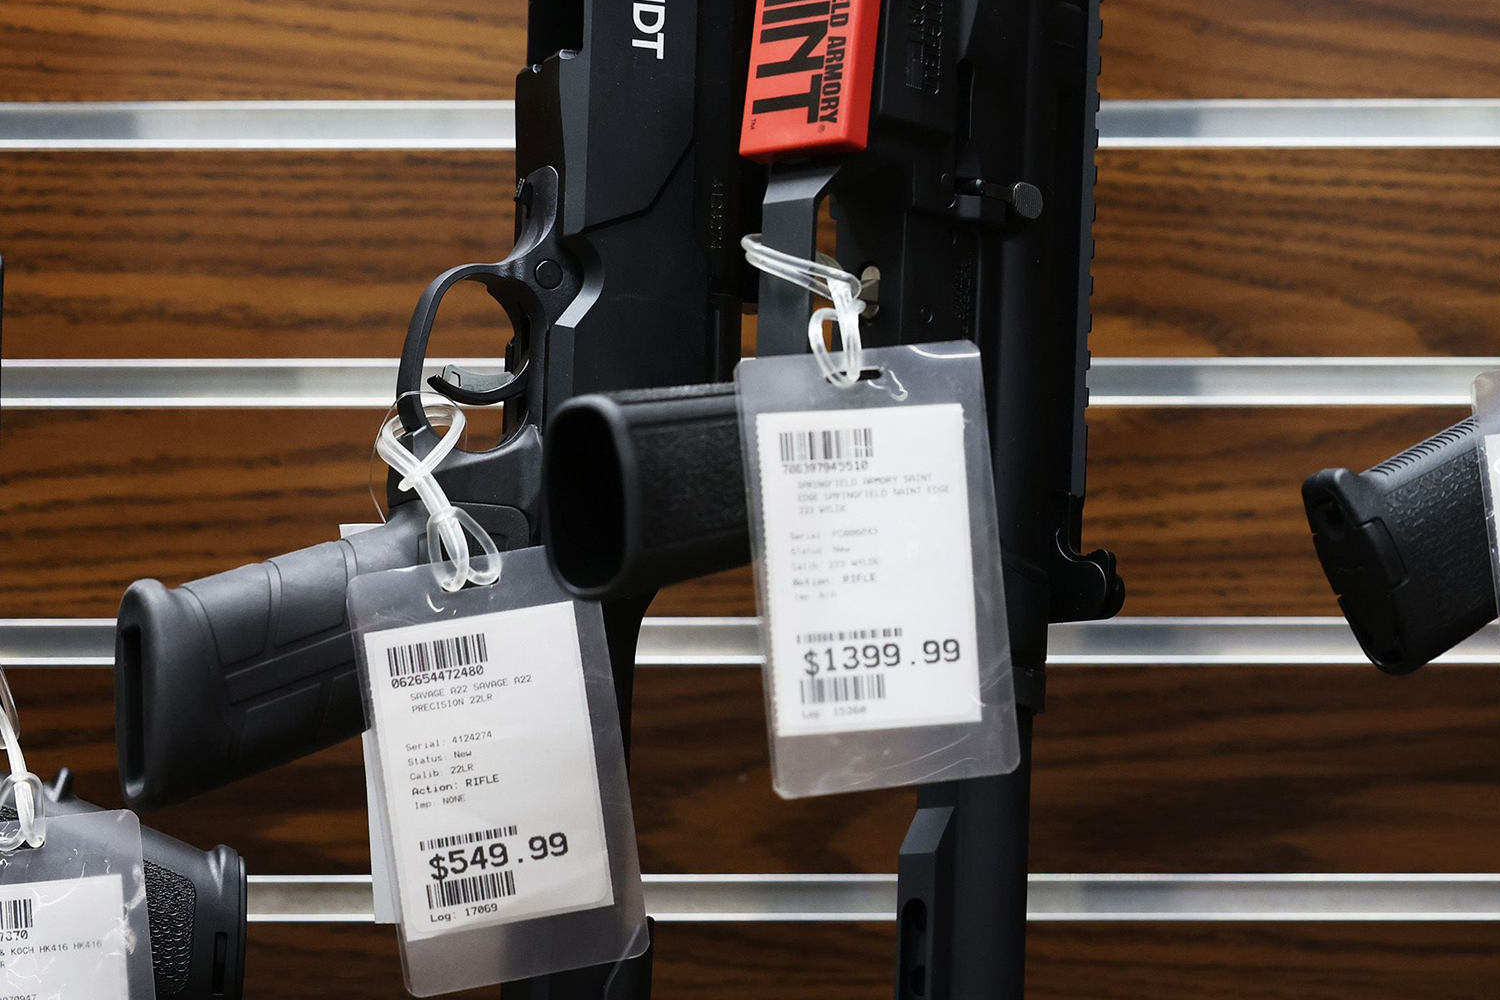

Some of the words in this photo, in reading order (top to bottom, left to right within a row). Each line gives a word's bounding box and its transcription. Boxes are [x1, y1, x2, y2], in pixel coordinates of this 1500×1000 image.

[818, 35, 847, 125] ARMORY
[803, 638, 961, 676] $1399.99
[390, 664, 485, 690] 062654472480
[409, 687, 446, 702] SAVAGE
[450, 684, 469, 696] A22
[472, 678, 509, 691] SAVAGE
[513, 674, 533, 685] A22
[411, 697, 465, 714] PRECISION
[469, 692, 494, 705] 22LR
[405, 739, 447, 752] Serial:
[451, 730, 493, 745] 4124274
[453, 748, 473, 760] New
[450, 762, 475, 775] 22LR
[411, 781, 459, 796] Action:
[465, 773, 501, 788] RIFLE
[442, 793, 467, 806] NONE
[428, 831, 570, 881] $549.99
[429, 910, 457, 924] Log:
[464, 902, 499, 918] 17069
[10, 946, 35, 956] KOCH
[39, 943, 69, 953] HK416
[73, 940, 103, 950] HK416
